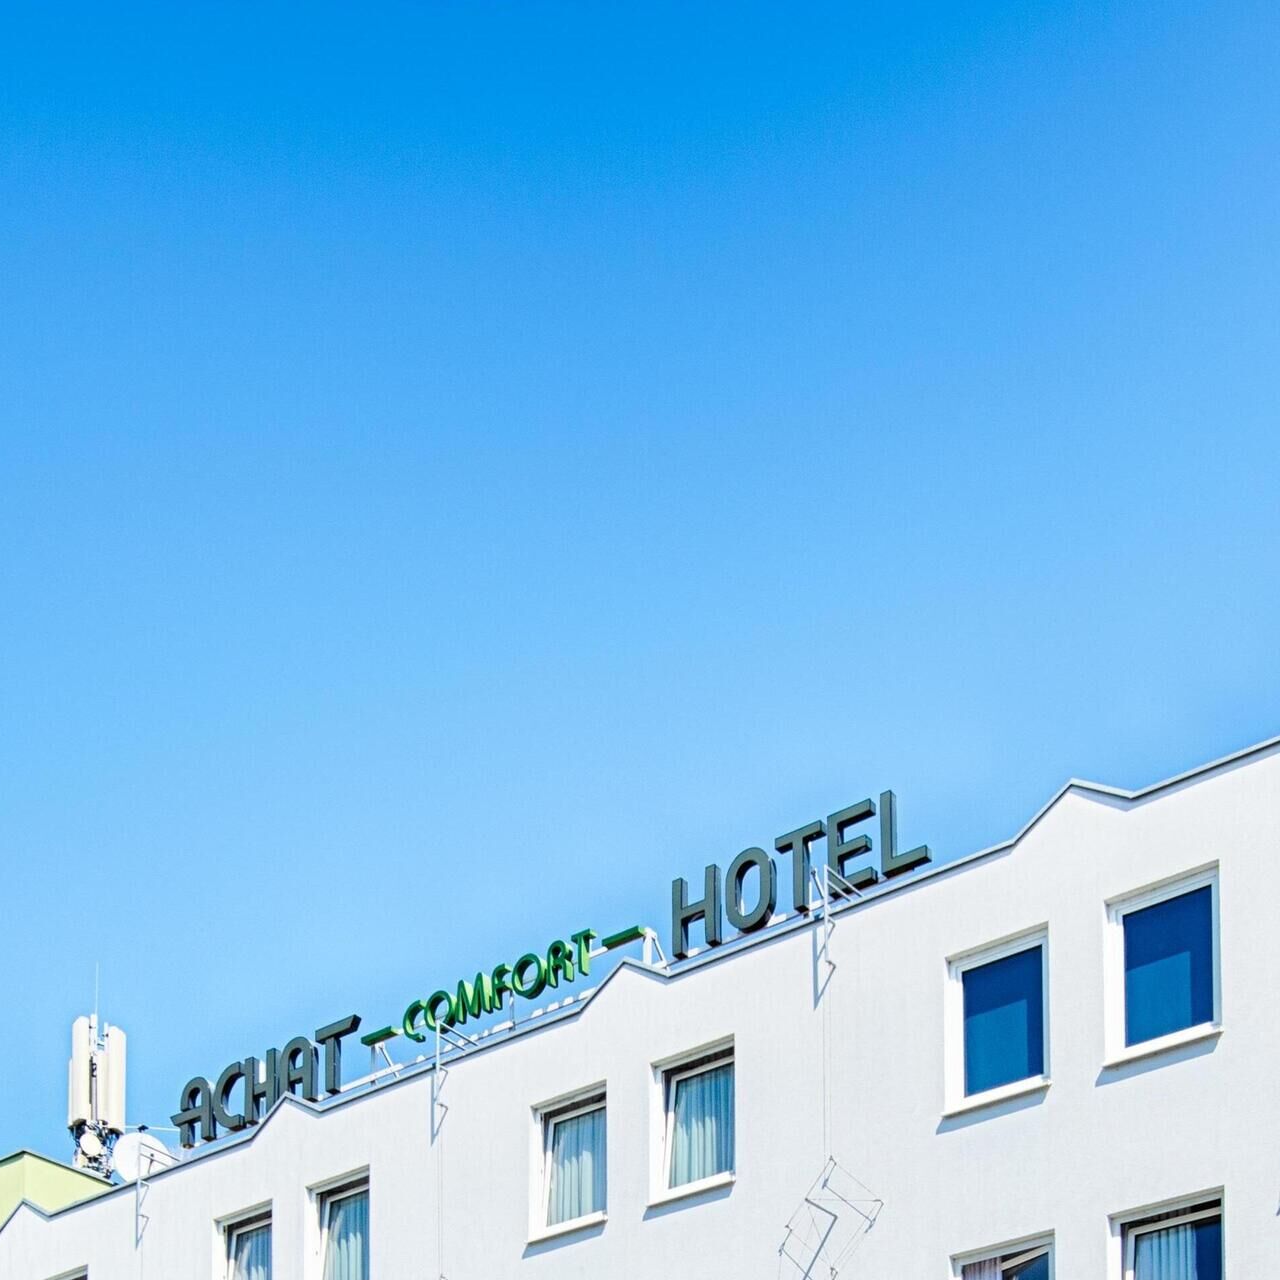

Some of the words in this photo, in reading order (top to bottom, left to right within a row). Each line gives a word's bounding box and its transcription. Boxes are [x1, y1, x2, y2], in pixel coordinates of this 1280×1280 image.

[171, 1014, 362, 1148] ACHAT
[403, 928, 598, 1043] COMFORT
[672, 790, 932, 960] HOTEL
